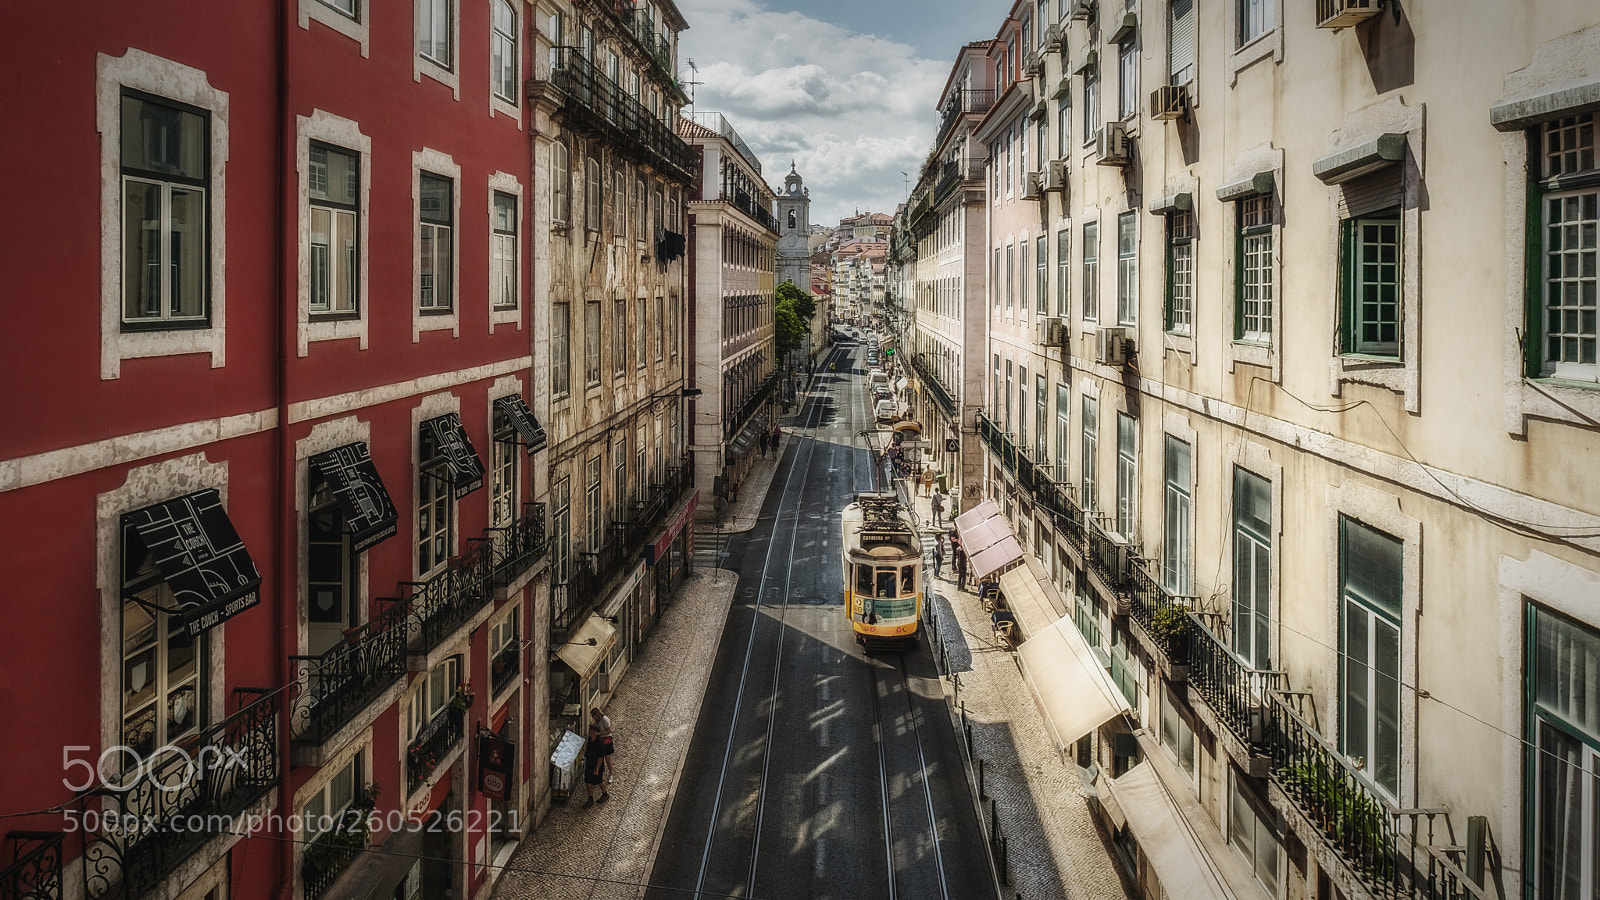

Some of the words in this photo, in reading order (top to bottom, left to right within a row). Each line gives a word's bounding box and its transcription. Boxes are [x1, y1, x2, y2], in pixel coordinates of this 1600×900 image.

[189, 619, 200, 635] THE
[201, 610, 219, 628] COUCH
[225, 597, 245, 616] SPORTS
[245, 592, 257, 606] BAR
